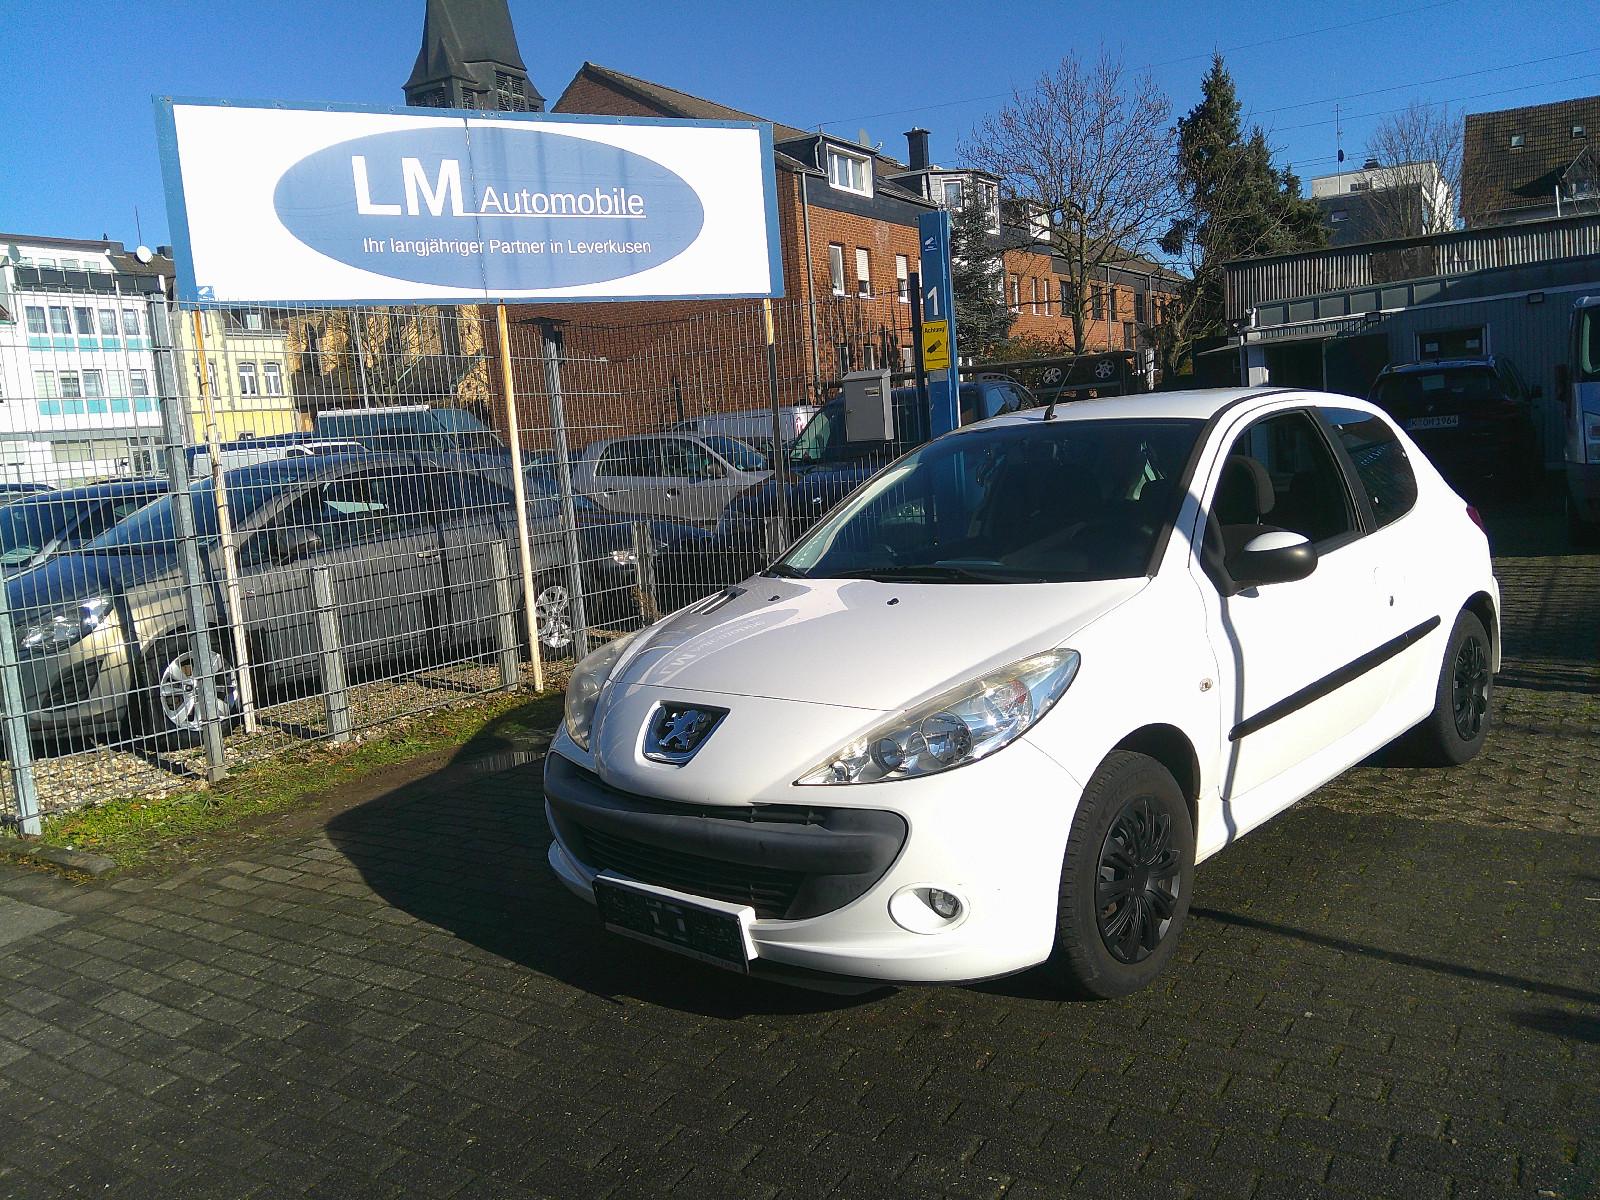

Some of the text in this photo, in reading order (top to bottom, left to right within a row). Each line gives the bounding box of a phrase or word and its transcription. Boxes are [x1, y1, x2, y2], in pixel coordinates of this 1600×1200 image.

[351, 155, 644, 217] LM Automobile
[363, 237, 651, 257] Ihr langjähriger Partner in Leverkusen
[927, 286, 939, 316] 1
